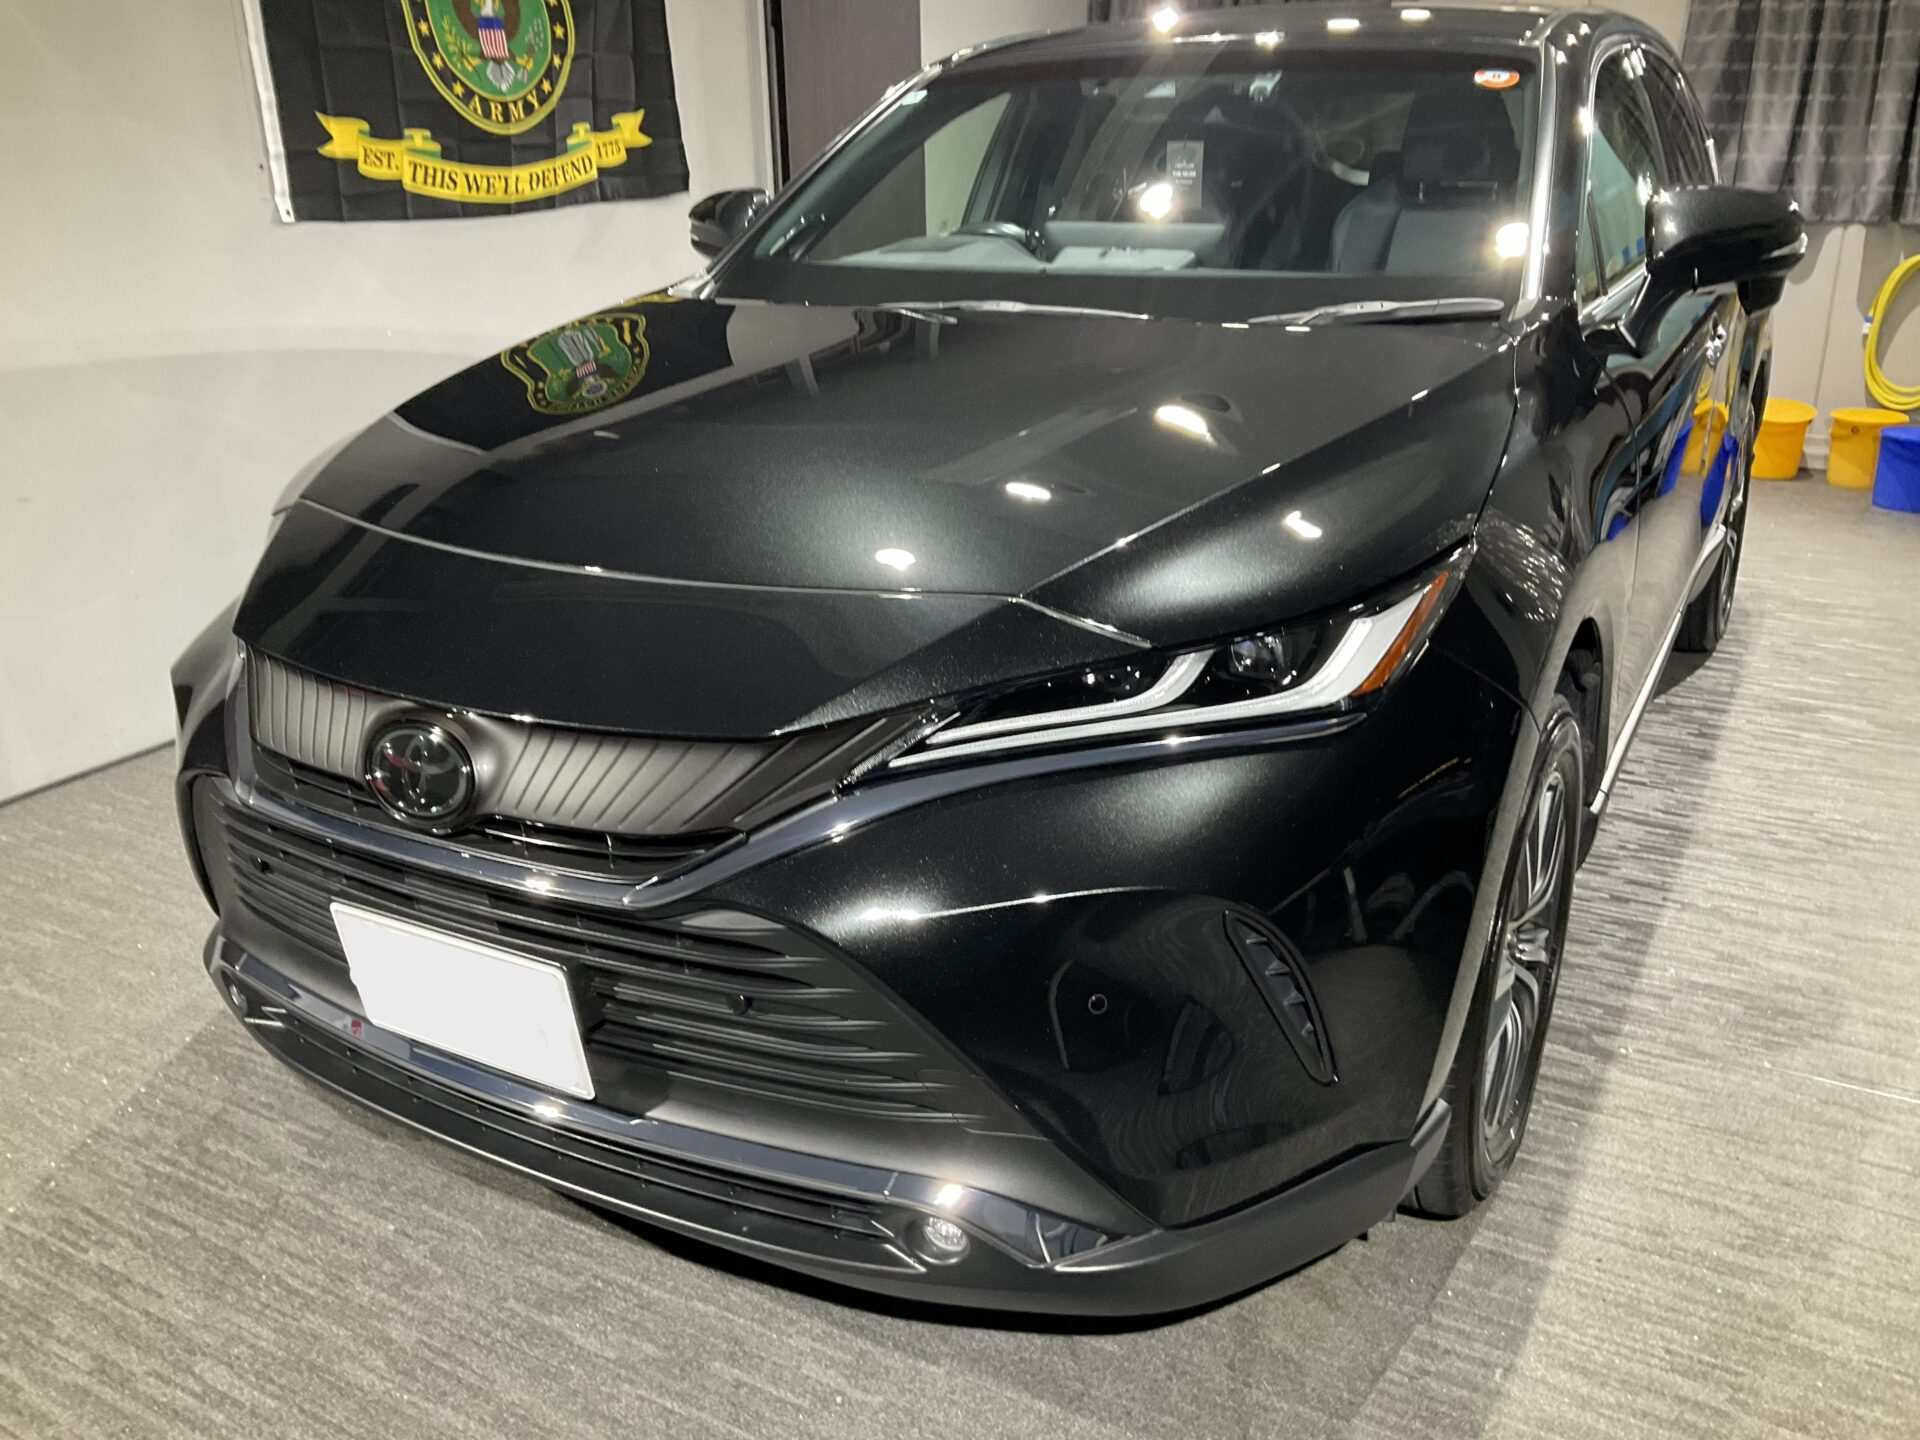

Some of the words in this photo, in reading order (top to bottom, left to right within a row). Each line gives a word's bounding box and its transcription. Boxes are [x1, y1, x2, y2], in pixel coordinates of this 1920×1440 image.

[469, 89, 541, 123] ARMY
[361, 146, 400, 170] EST.
[597, 138, 621, 159] 1775
[409, 161, 459, 191] THIS
[463, 171, 525, 195] WE'LL
[528, 154, 593, 191] DEFEND
